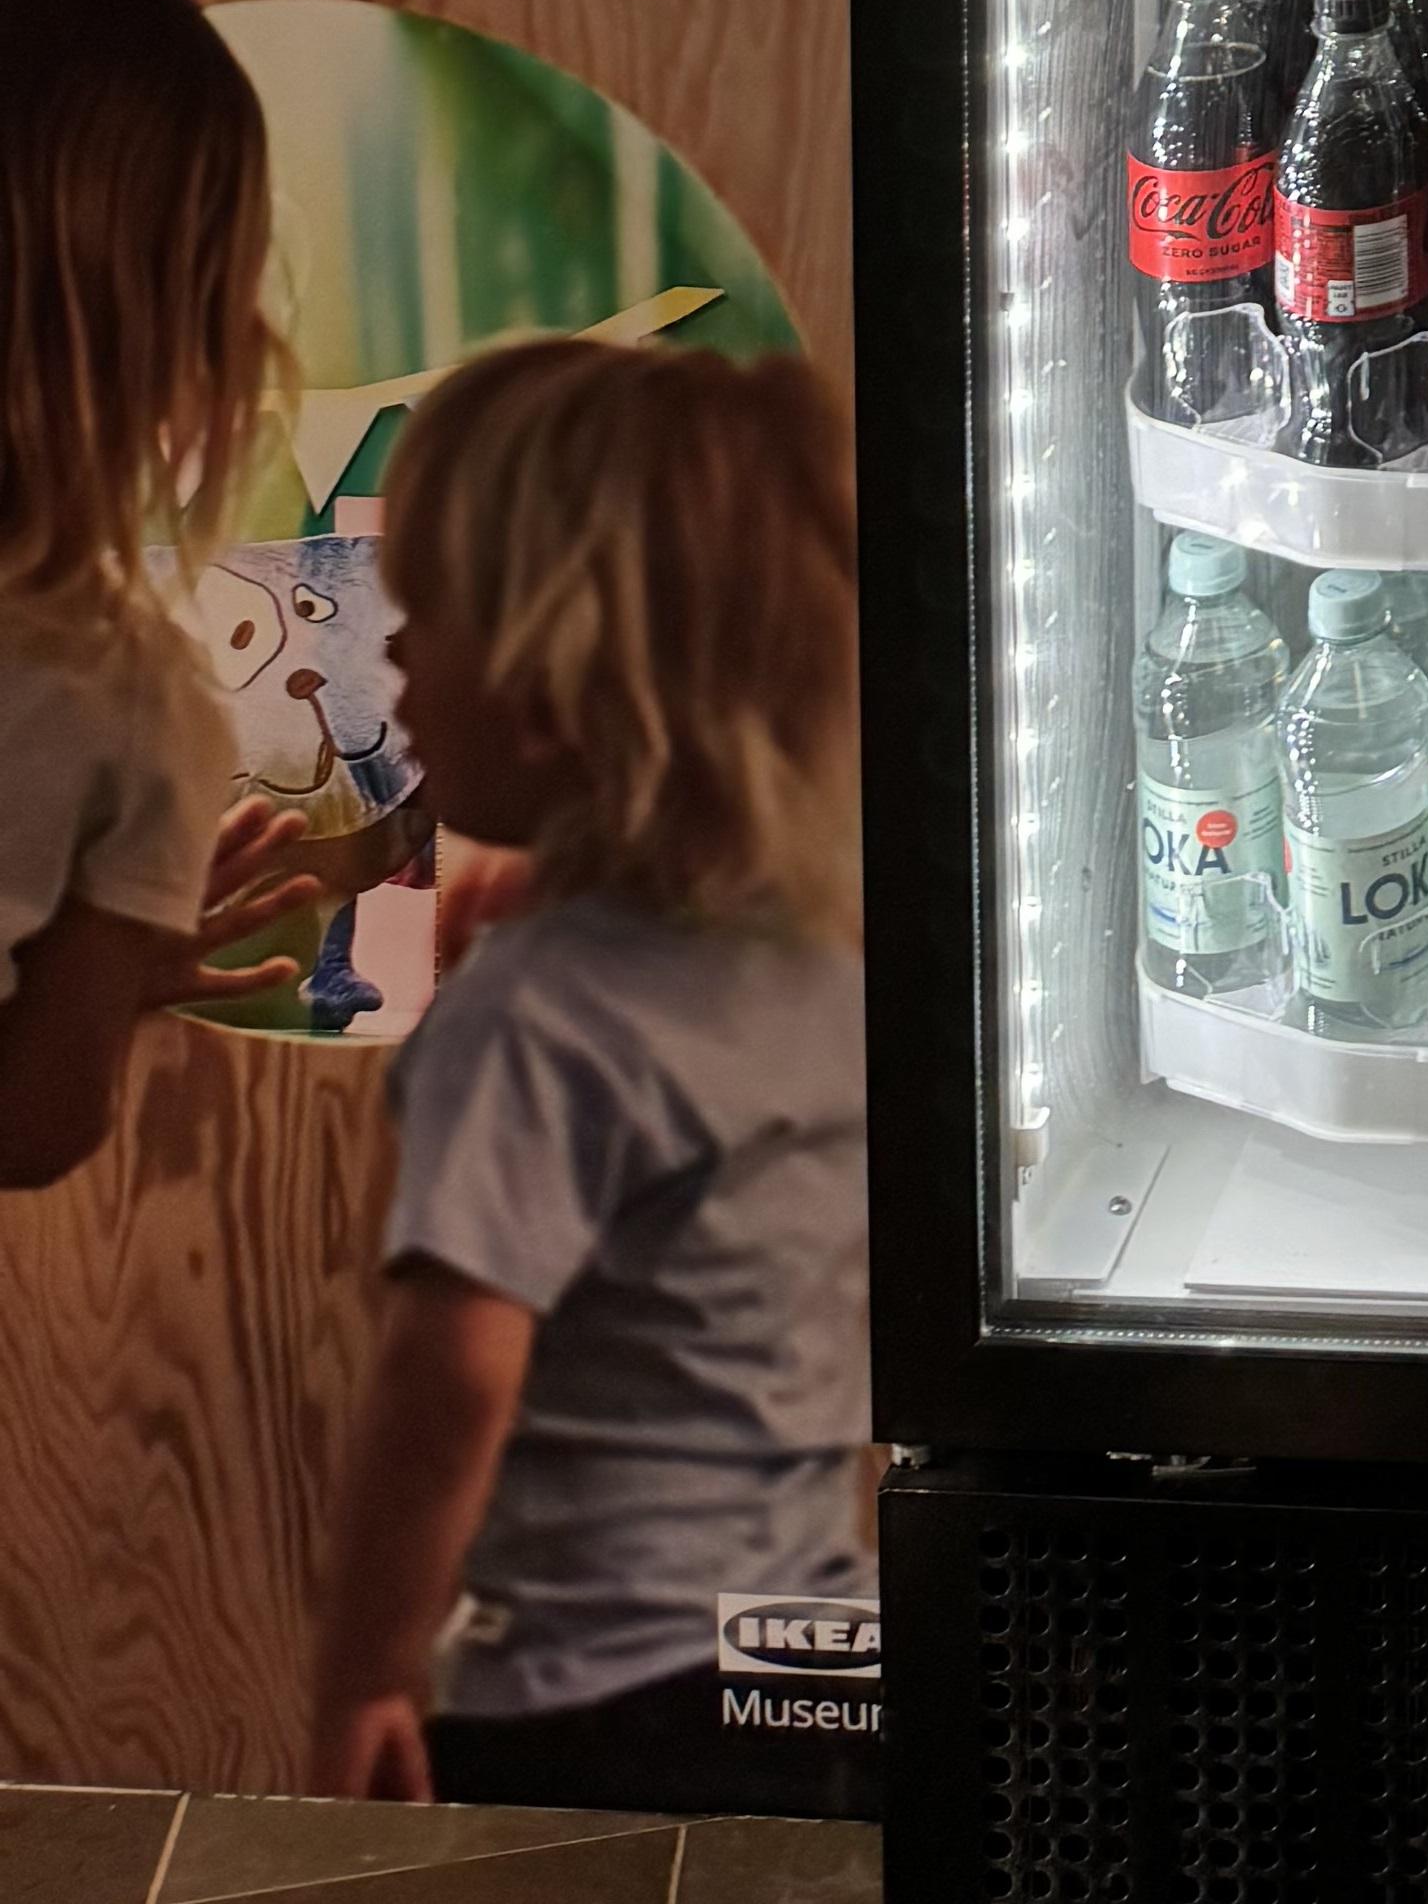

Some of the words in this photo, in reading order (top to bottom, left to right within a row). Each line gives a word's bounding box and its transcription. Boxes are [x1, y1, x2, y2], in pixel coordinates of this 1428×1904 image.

[1162, 245, 1203, 258] ZERO
[1208, 235, 1262, 258] SUGAR
[1142, 817, 1231, 876] OKA
[738, 1616, 881, 1652] IKEA
